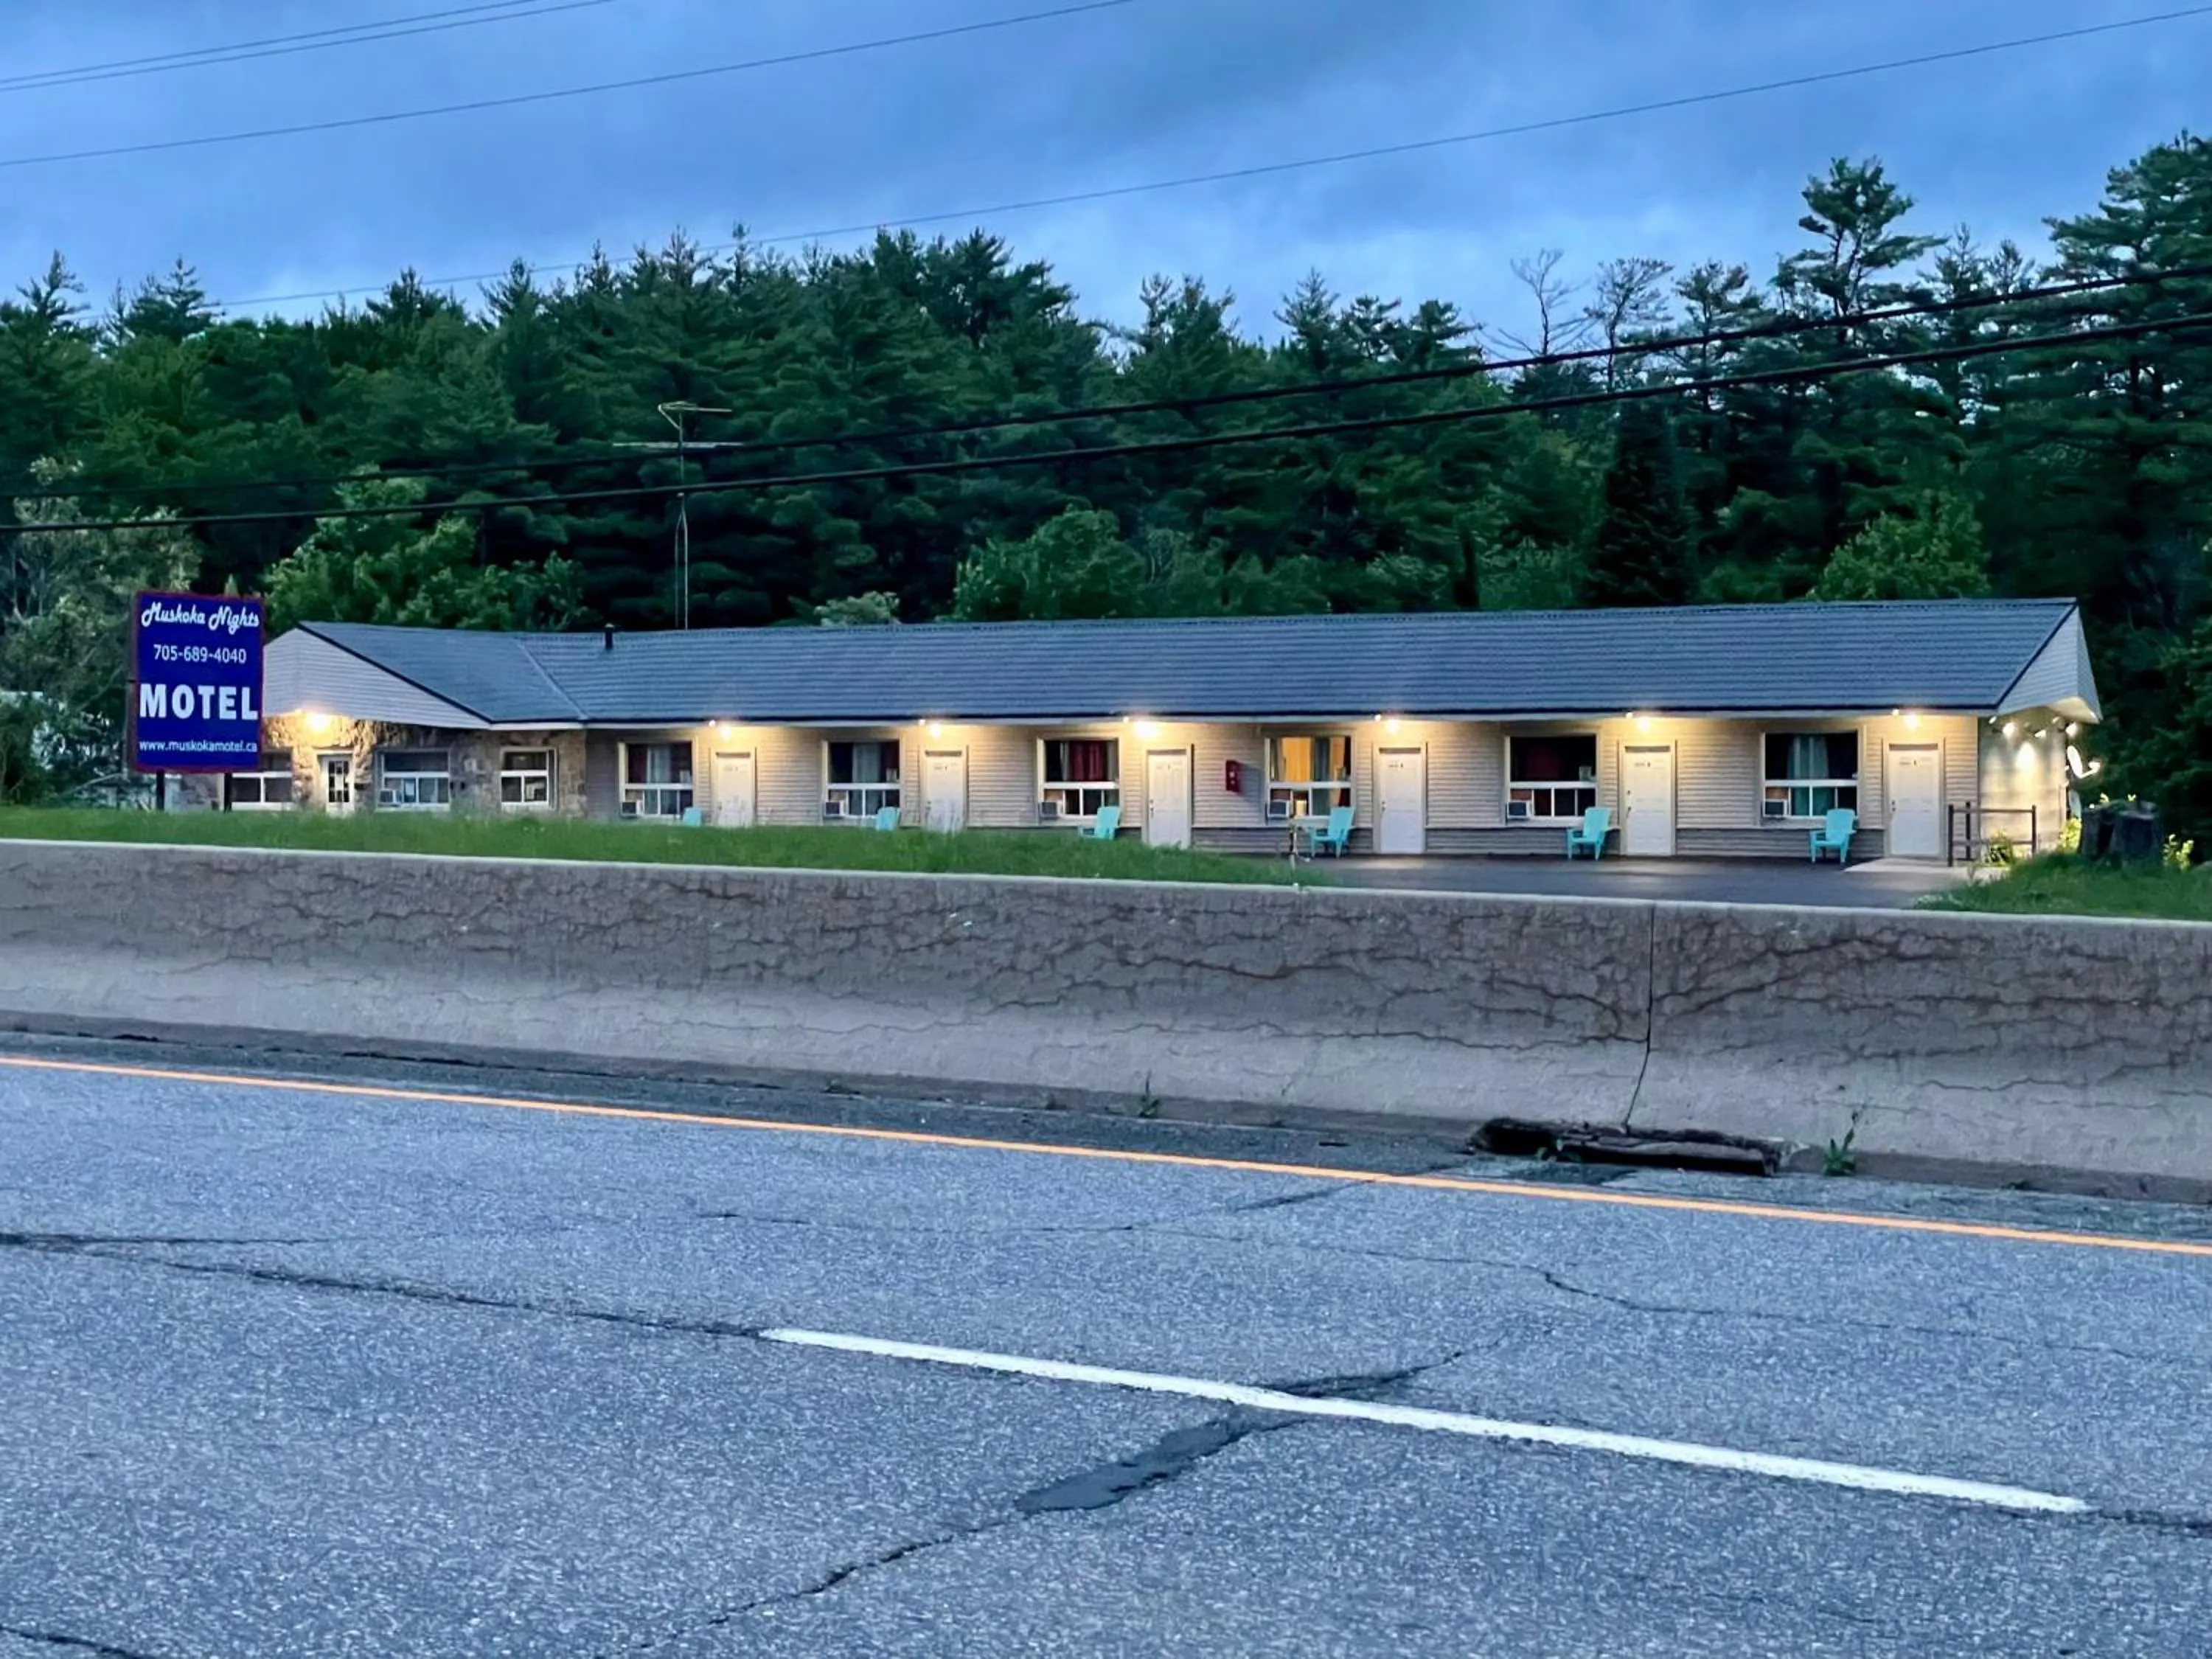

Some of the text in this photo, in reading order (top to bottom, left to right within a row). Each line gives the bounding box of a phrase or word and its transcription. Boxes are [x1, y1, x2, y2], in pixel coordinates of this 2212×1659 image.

[142, 602, 206, 627] Muskoka
[153, 644, 247, 664] 705-689-4040
[139, 683, 258, 720] MOTEL
[139, 740, 257, 752] www.muskokamotel.ca
